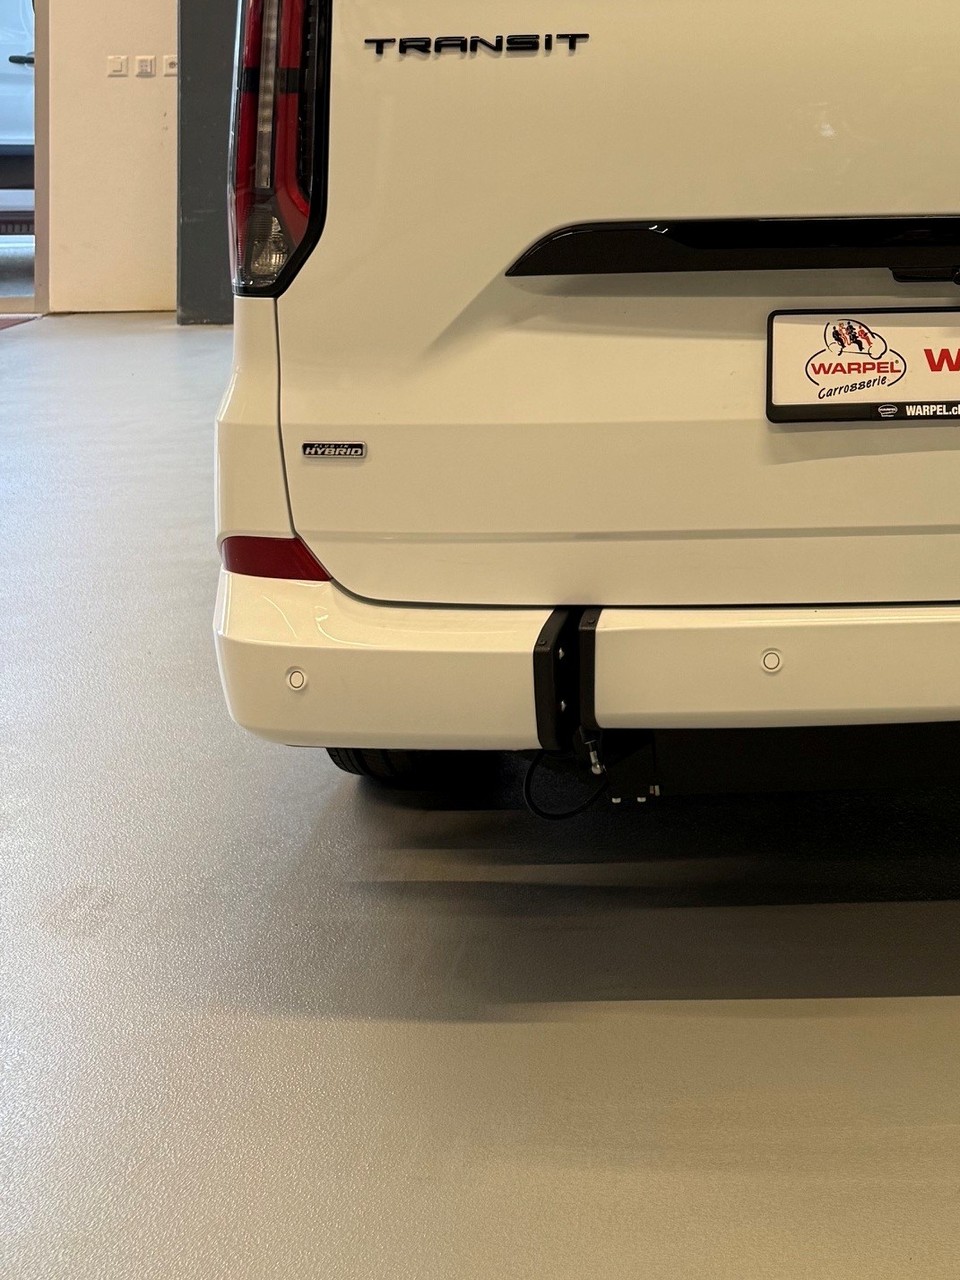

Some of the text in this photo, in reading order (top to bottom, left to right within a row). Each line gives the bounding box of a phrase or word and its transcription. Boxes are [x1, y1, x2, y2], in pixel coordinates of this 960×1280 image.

[364, 33, 590, 55] TRANSIT
[811, 361, 901, 375] WARPEL
[818, 376, 887, 399] Carrosserie
[305, 447, 362, 455] HYBRID
